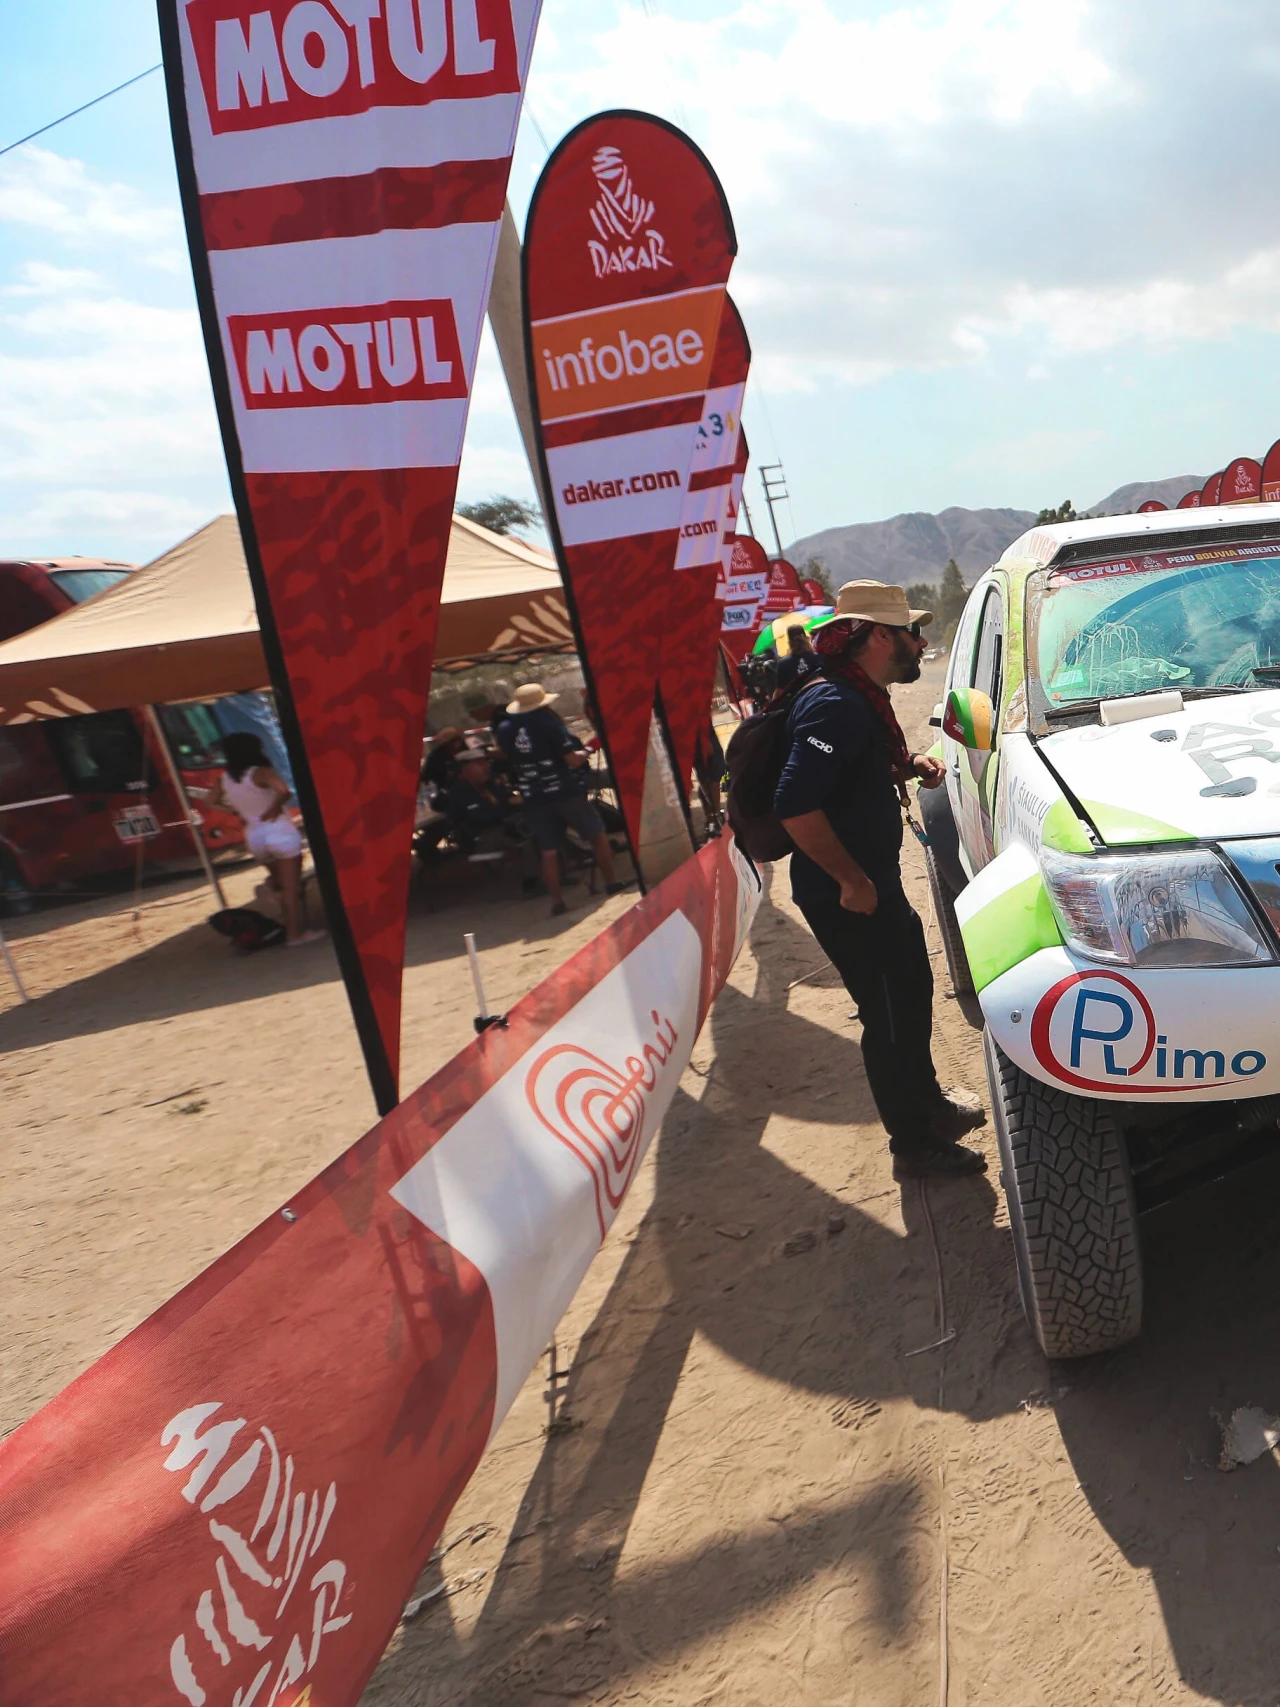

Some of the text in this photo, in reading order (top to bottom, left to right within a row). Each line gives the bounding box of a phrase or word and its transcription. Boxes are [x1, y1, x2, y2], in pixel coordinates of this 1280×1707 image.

[214, 0, 496, 111] MOTUL
[587, 229, 674, 279] DAKAR
[246, 315, 453, 395] MOTUL
[543, 326, 704, 391] infobae
[562, 466, 680, 505] dakar.com
[1234, 482, 1256, 494] DAKAR
[1060, 562, 1131, 580] MOTUL
[1166, 554, 1196, 564] PERU
[1196, 549, 1238, 561] BOLIVIA
